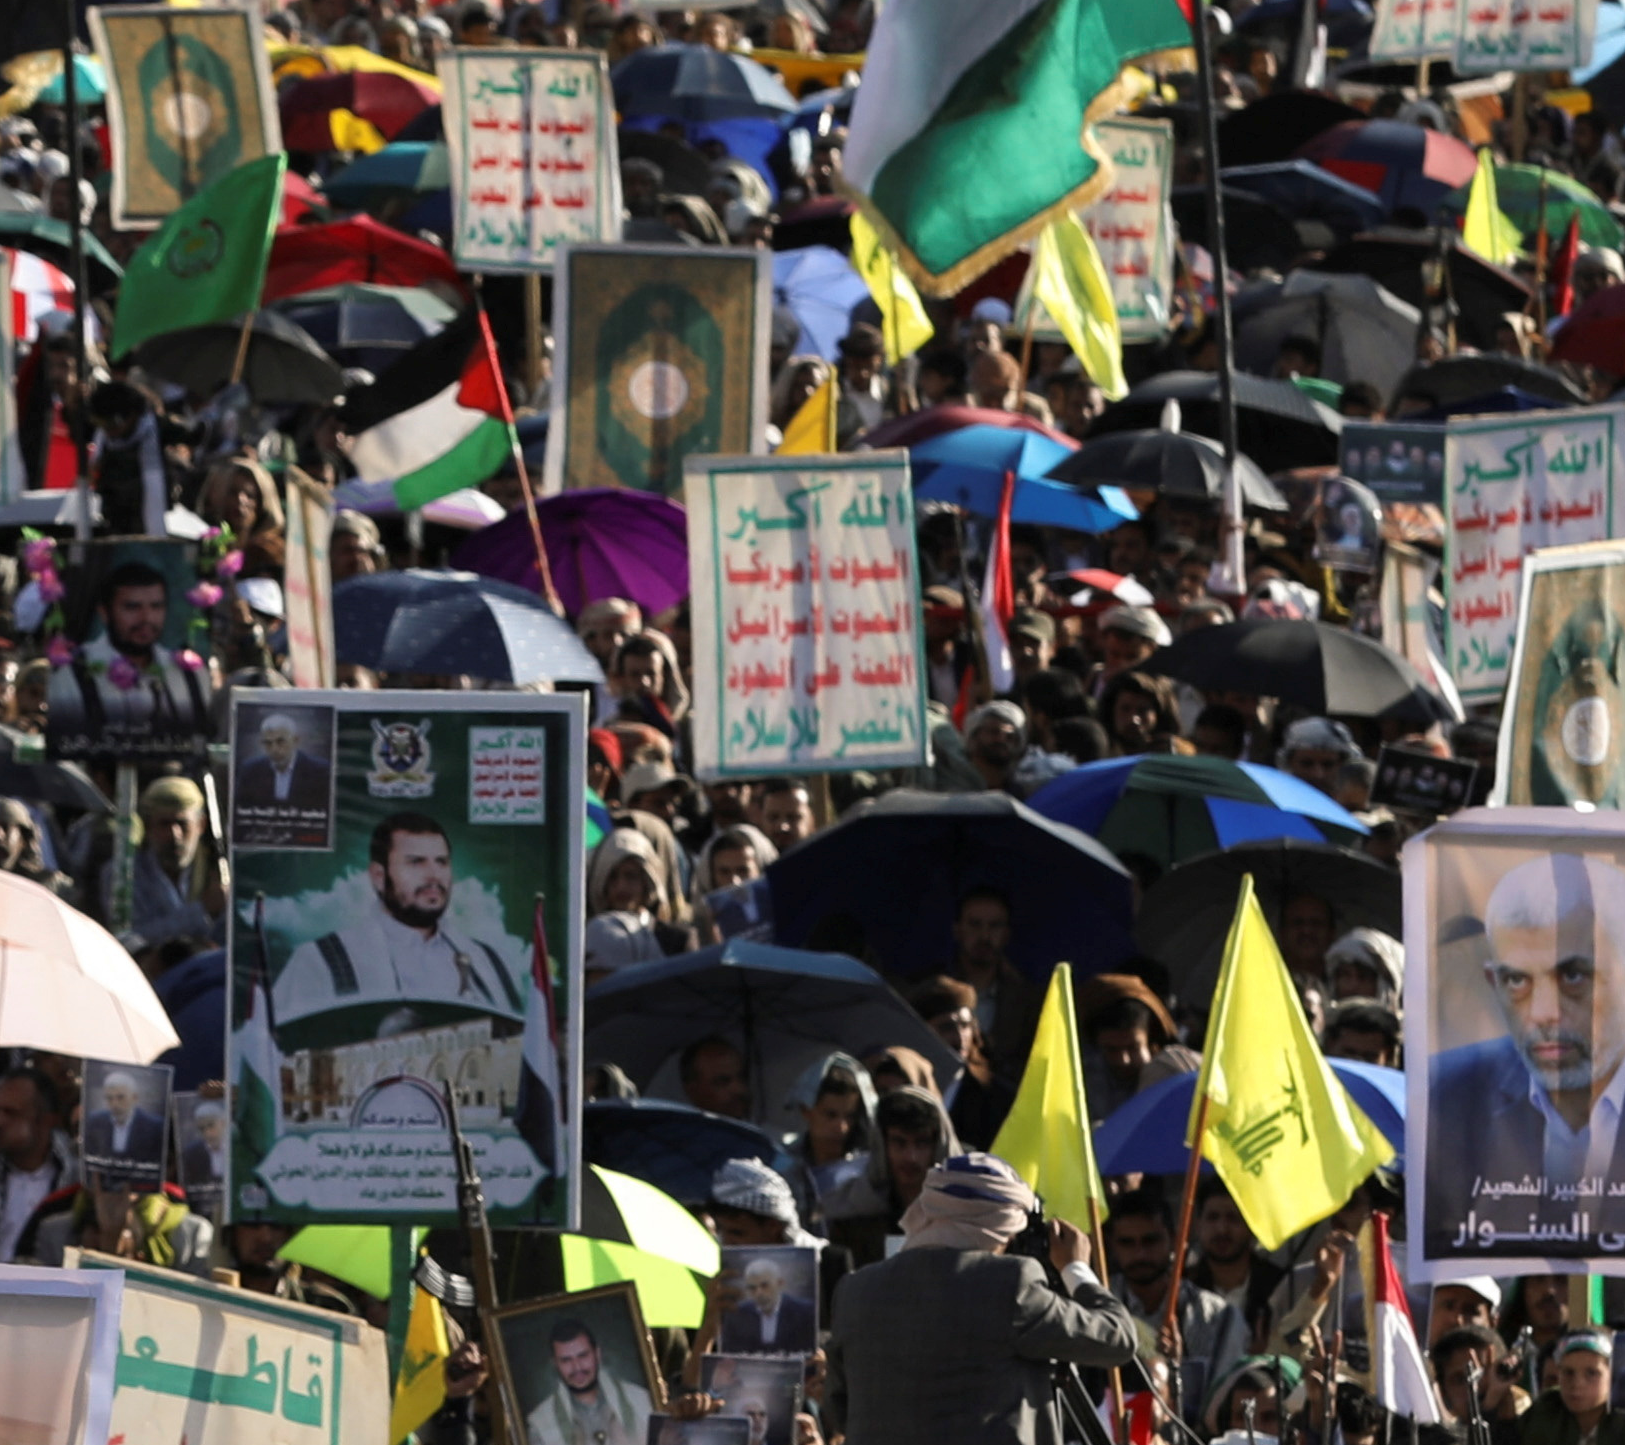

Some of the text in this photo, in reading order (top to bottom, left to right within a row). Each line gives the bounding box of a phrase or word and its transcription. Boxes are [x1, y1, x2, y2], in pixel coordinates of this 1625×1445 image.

[727, 478, 910, 540] الله أكبر
[1552, 1176, 1603, 1201] الكبير
[1452, 1210, 1590, 1247] السنوار
